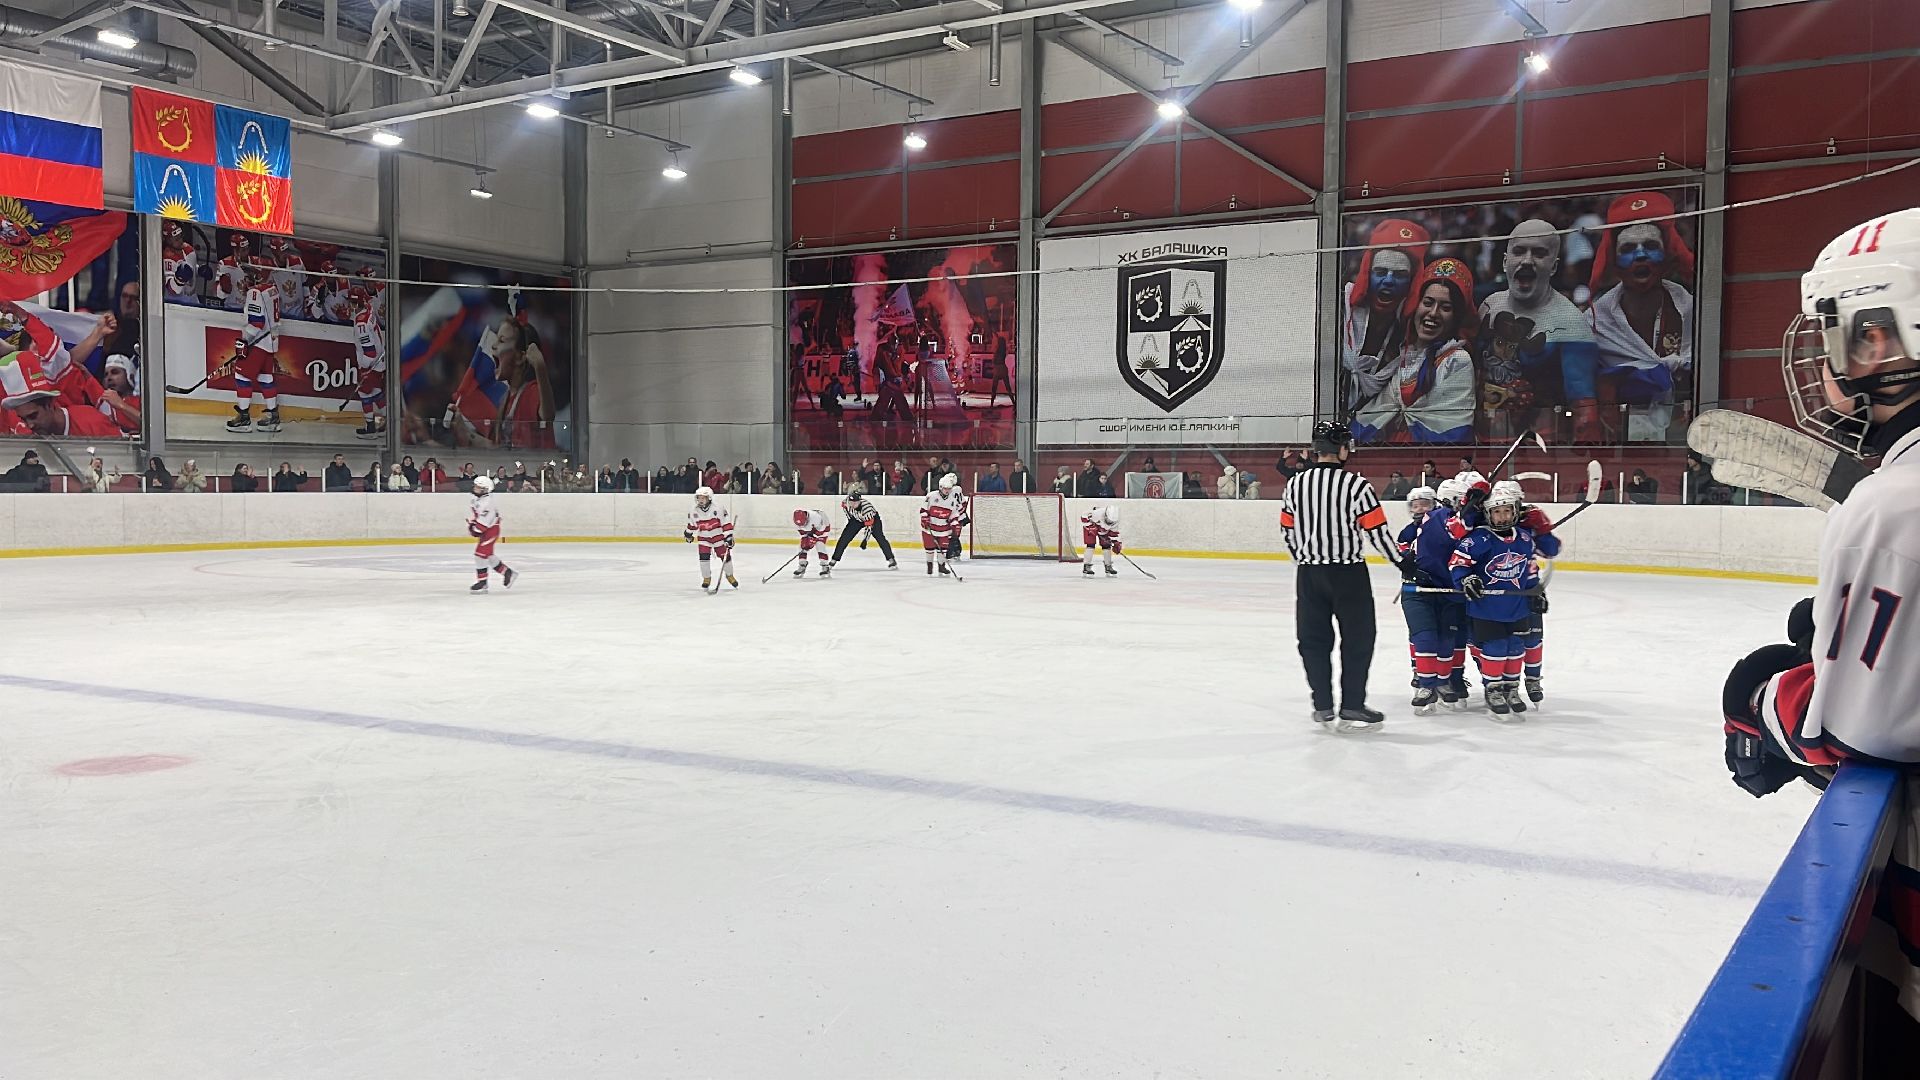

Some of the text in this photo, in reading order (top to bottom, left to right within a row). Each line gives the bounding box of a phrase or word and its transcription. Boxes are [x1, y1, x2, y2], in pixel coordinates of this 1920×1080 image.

[1848, 220, 1888, 256] 11
[1118, 243, 1228, 264] ХК БАЛАШИХА
[1839, 282, 1893, 299] CCM
[1129, 424, 1166, 432] ИМЕНИ
[1168, 423, 1240, 431] Ю.Е.ЛЯПКИНА
[1826, 582, 1903, 672] 11
